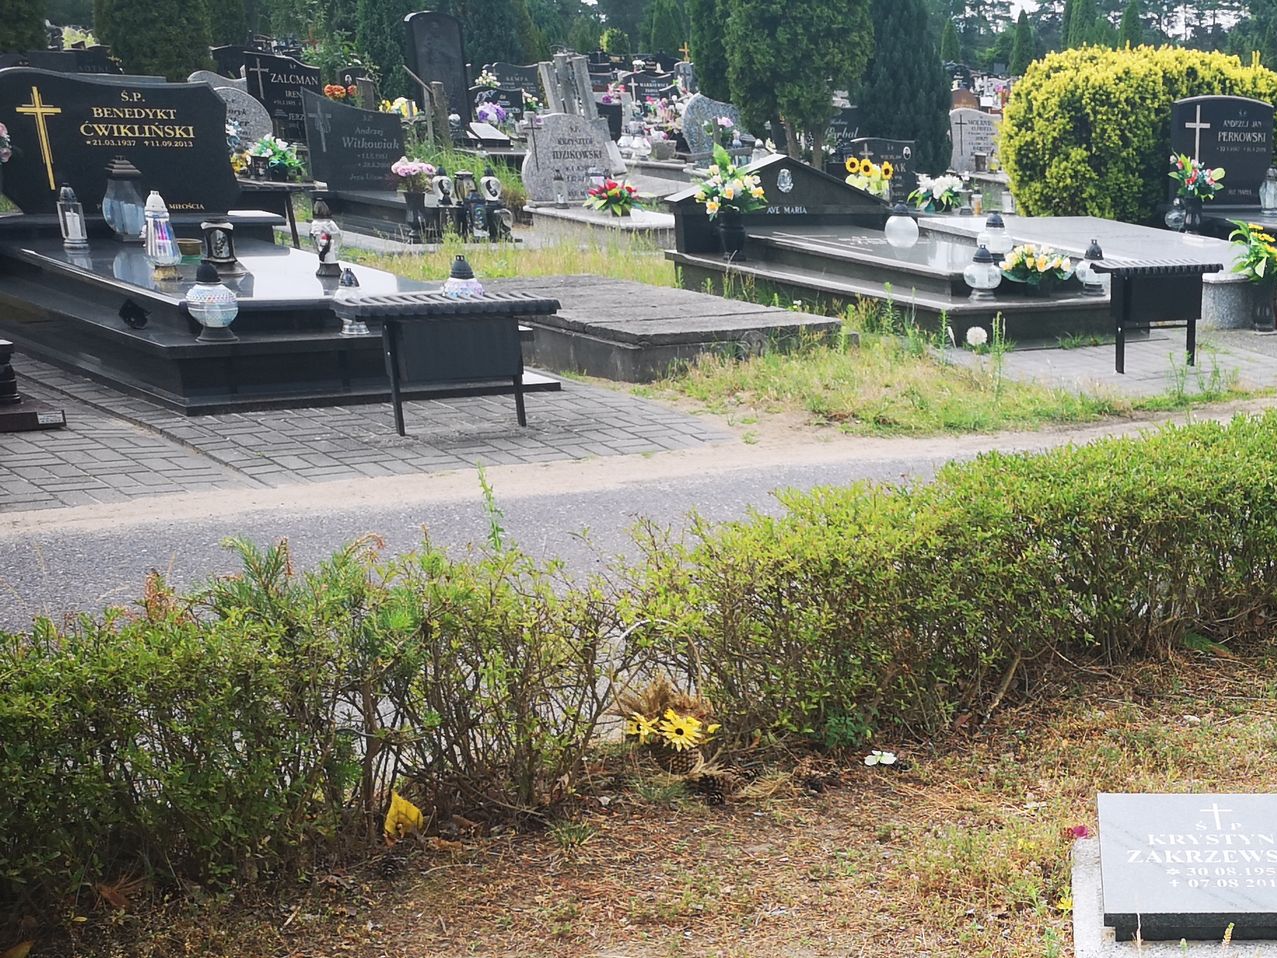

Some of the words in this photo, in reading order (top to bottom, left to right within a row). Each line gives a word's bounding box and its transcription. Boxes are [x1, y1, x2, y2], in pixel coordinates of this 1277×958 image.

[270, 73, 319, 86] ZALCMAN
[91, 107, 177, 120] BENEDYKT
[79, 121, 195, 138] ĆWIKLIŃSKI
[1217, 131, 1267, 143] PERKOWSKI
[766, 206, 781, 215] AVE
[783, 206, 808, 215] MARIA
